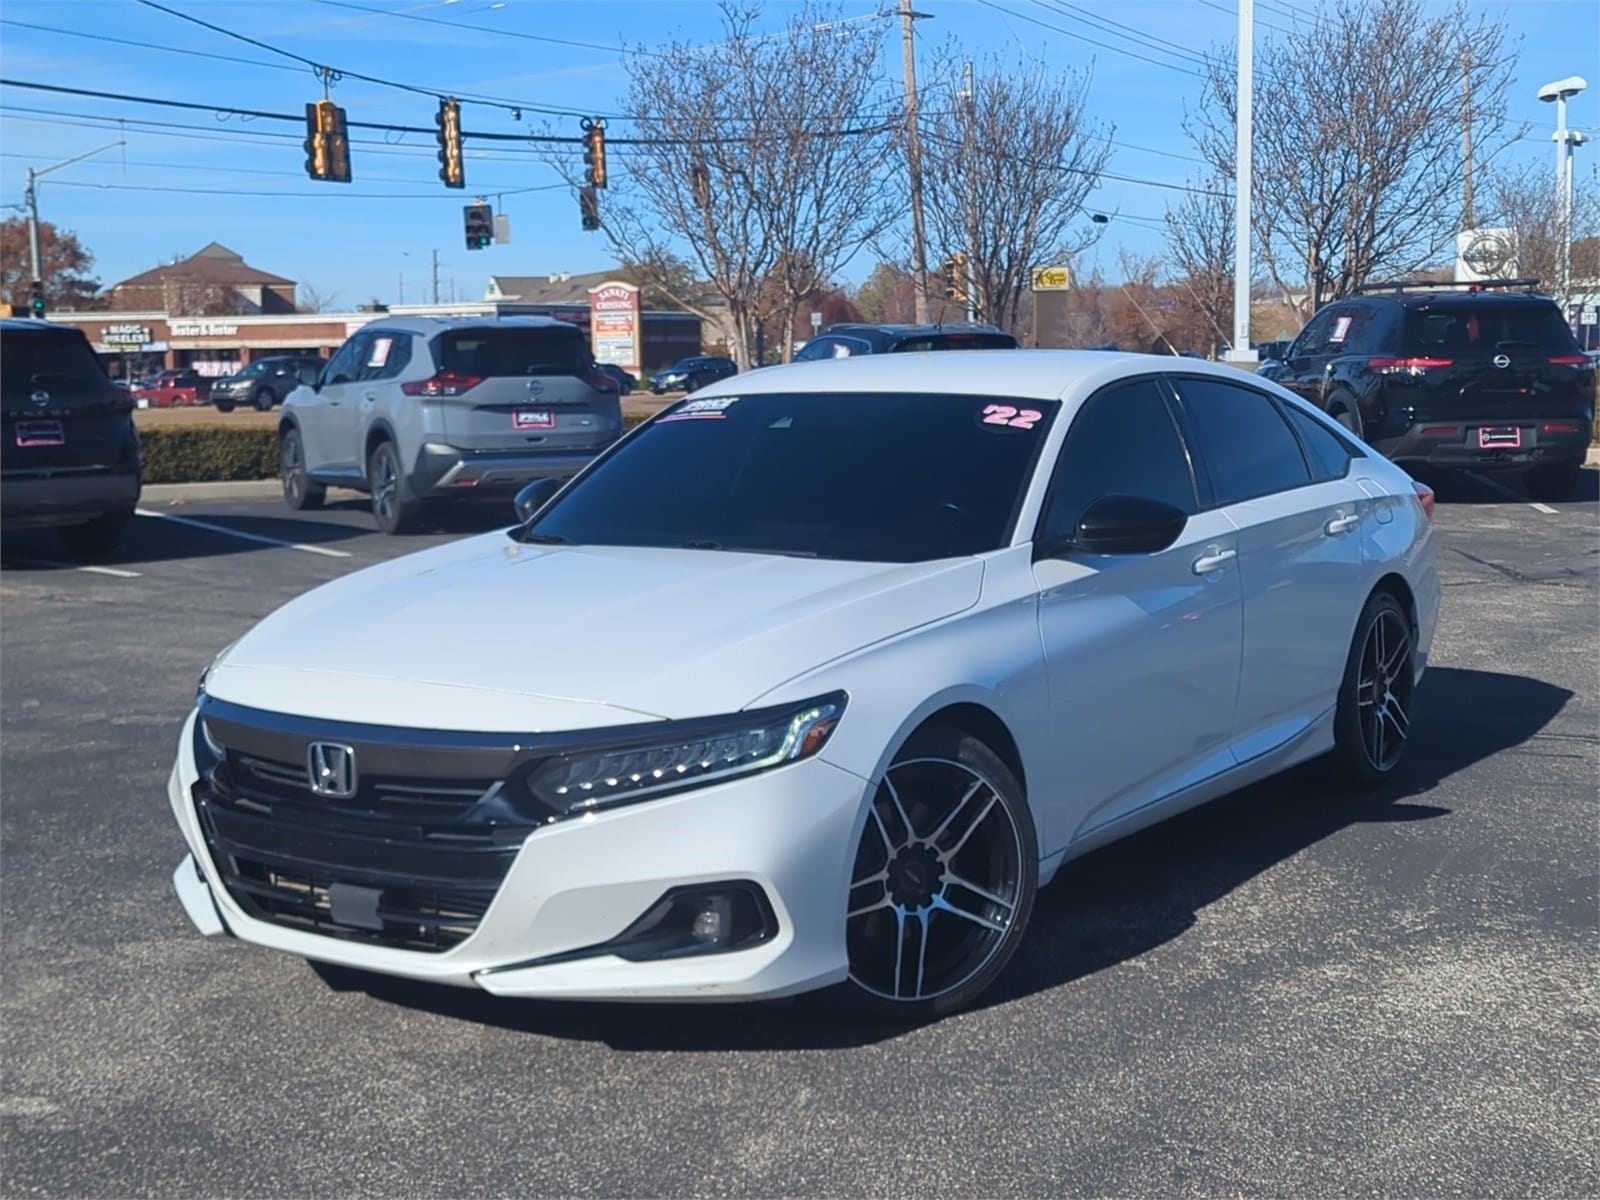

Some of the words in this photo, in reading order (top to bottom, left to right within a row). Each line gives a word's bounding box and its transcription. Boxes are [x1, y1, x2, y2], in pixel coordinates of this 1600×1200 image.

[596, 301, 633, 310] CROSSING
[103, 334, 151, 343] WIRELESS
[982, 404, 1042, 430] '22
